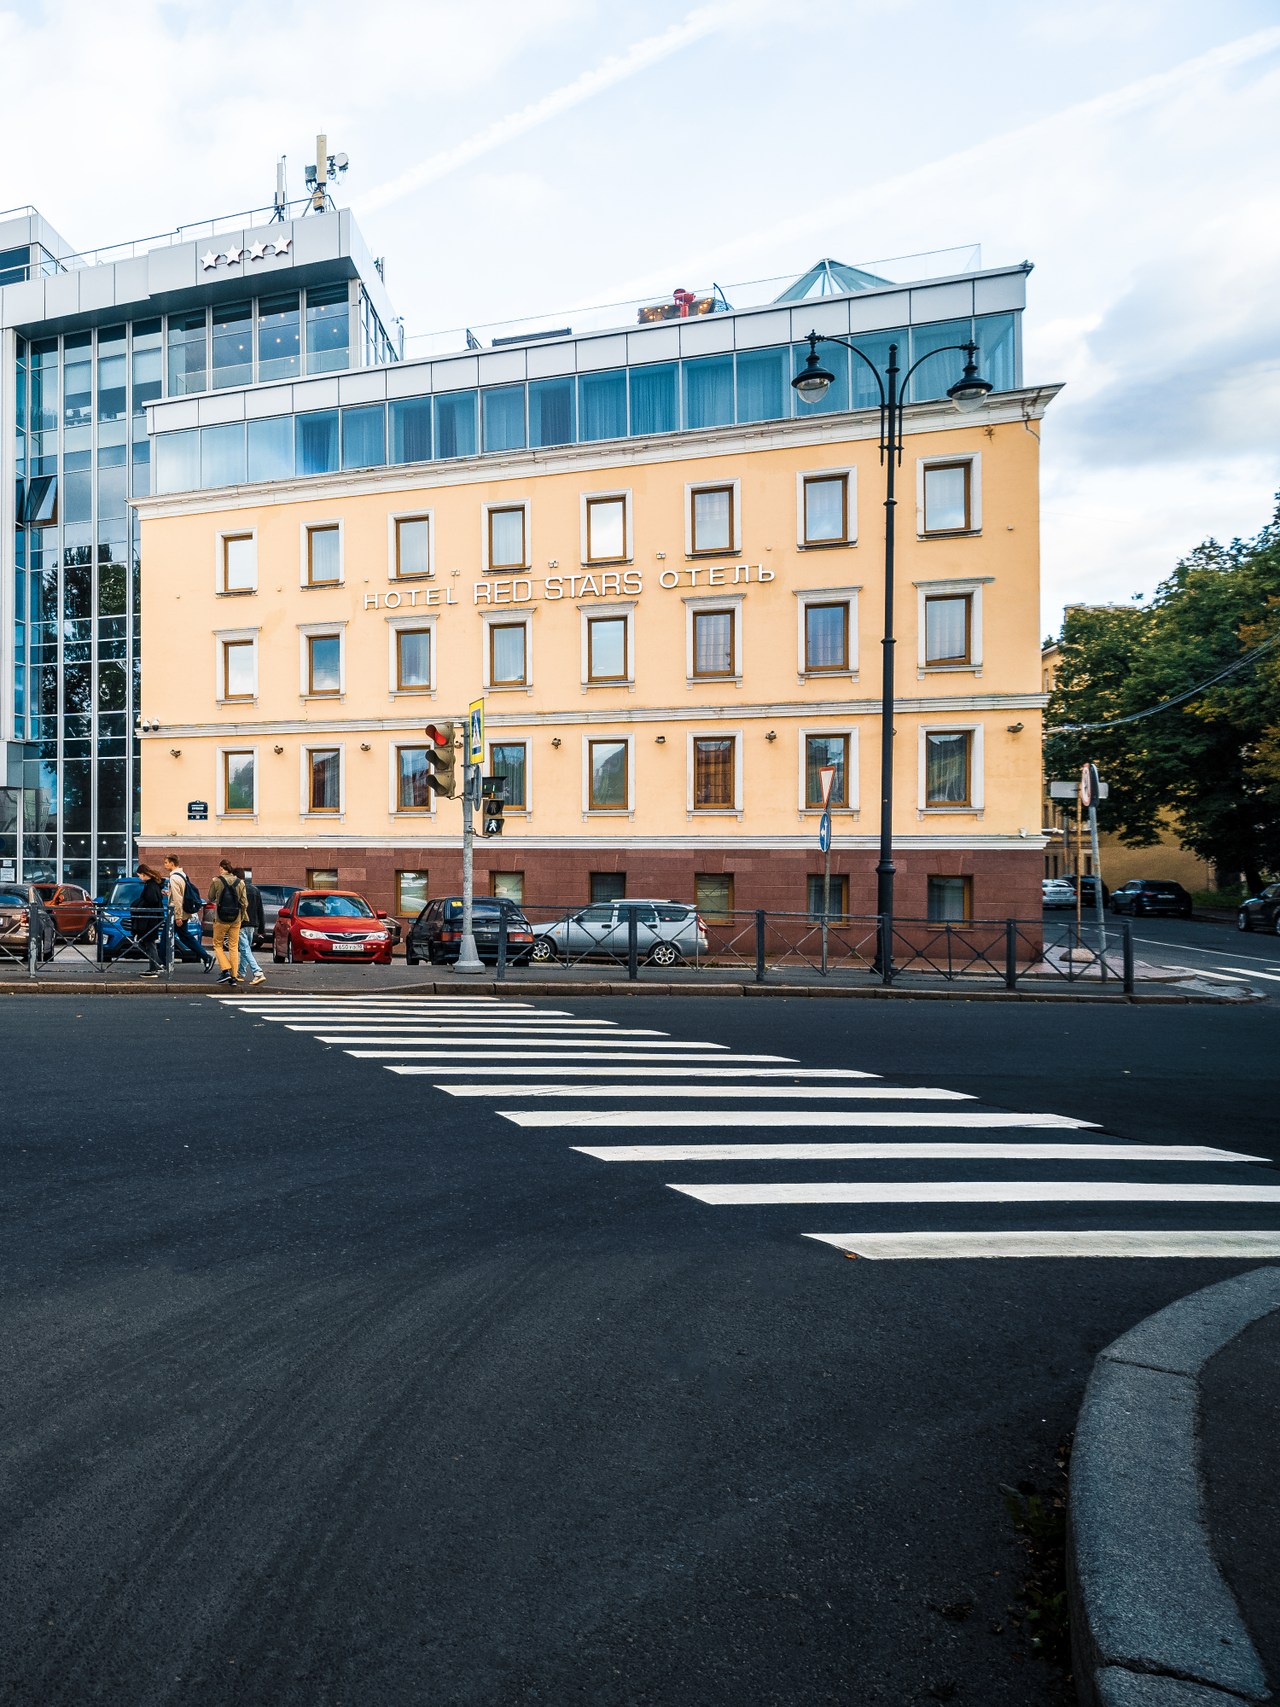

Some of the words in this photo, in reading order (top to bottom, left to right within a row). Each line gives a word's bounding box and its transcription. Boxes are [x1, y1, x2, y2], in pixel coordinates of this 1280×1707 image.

[364, 587, 458, 610] HOTEL
[473, 579, 532, 605] RED
[544, 570, 643, 600] STARS
[659, 564, 775, 589] ОТЕЛЬ
